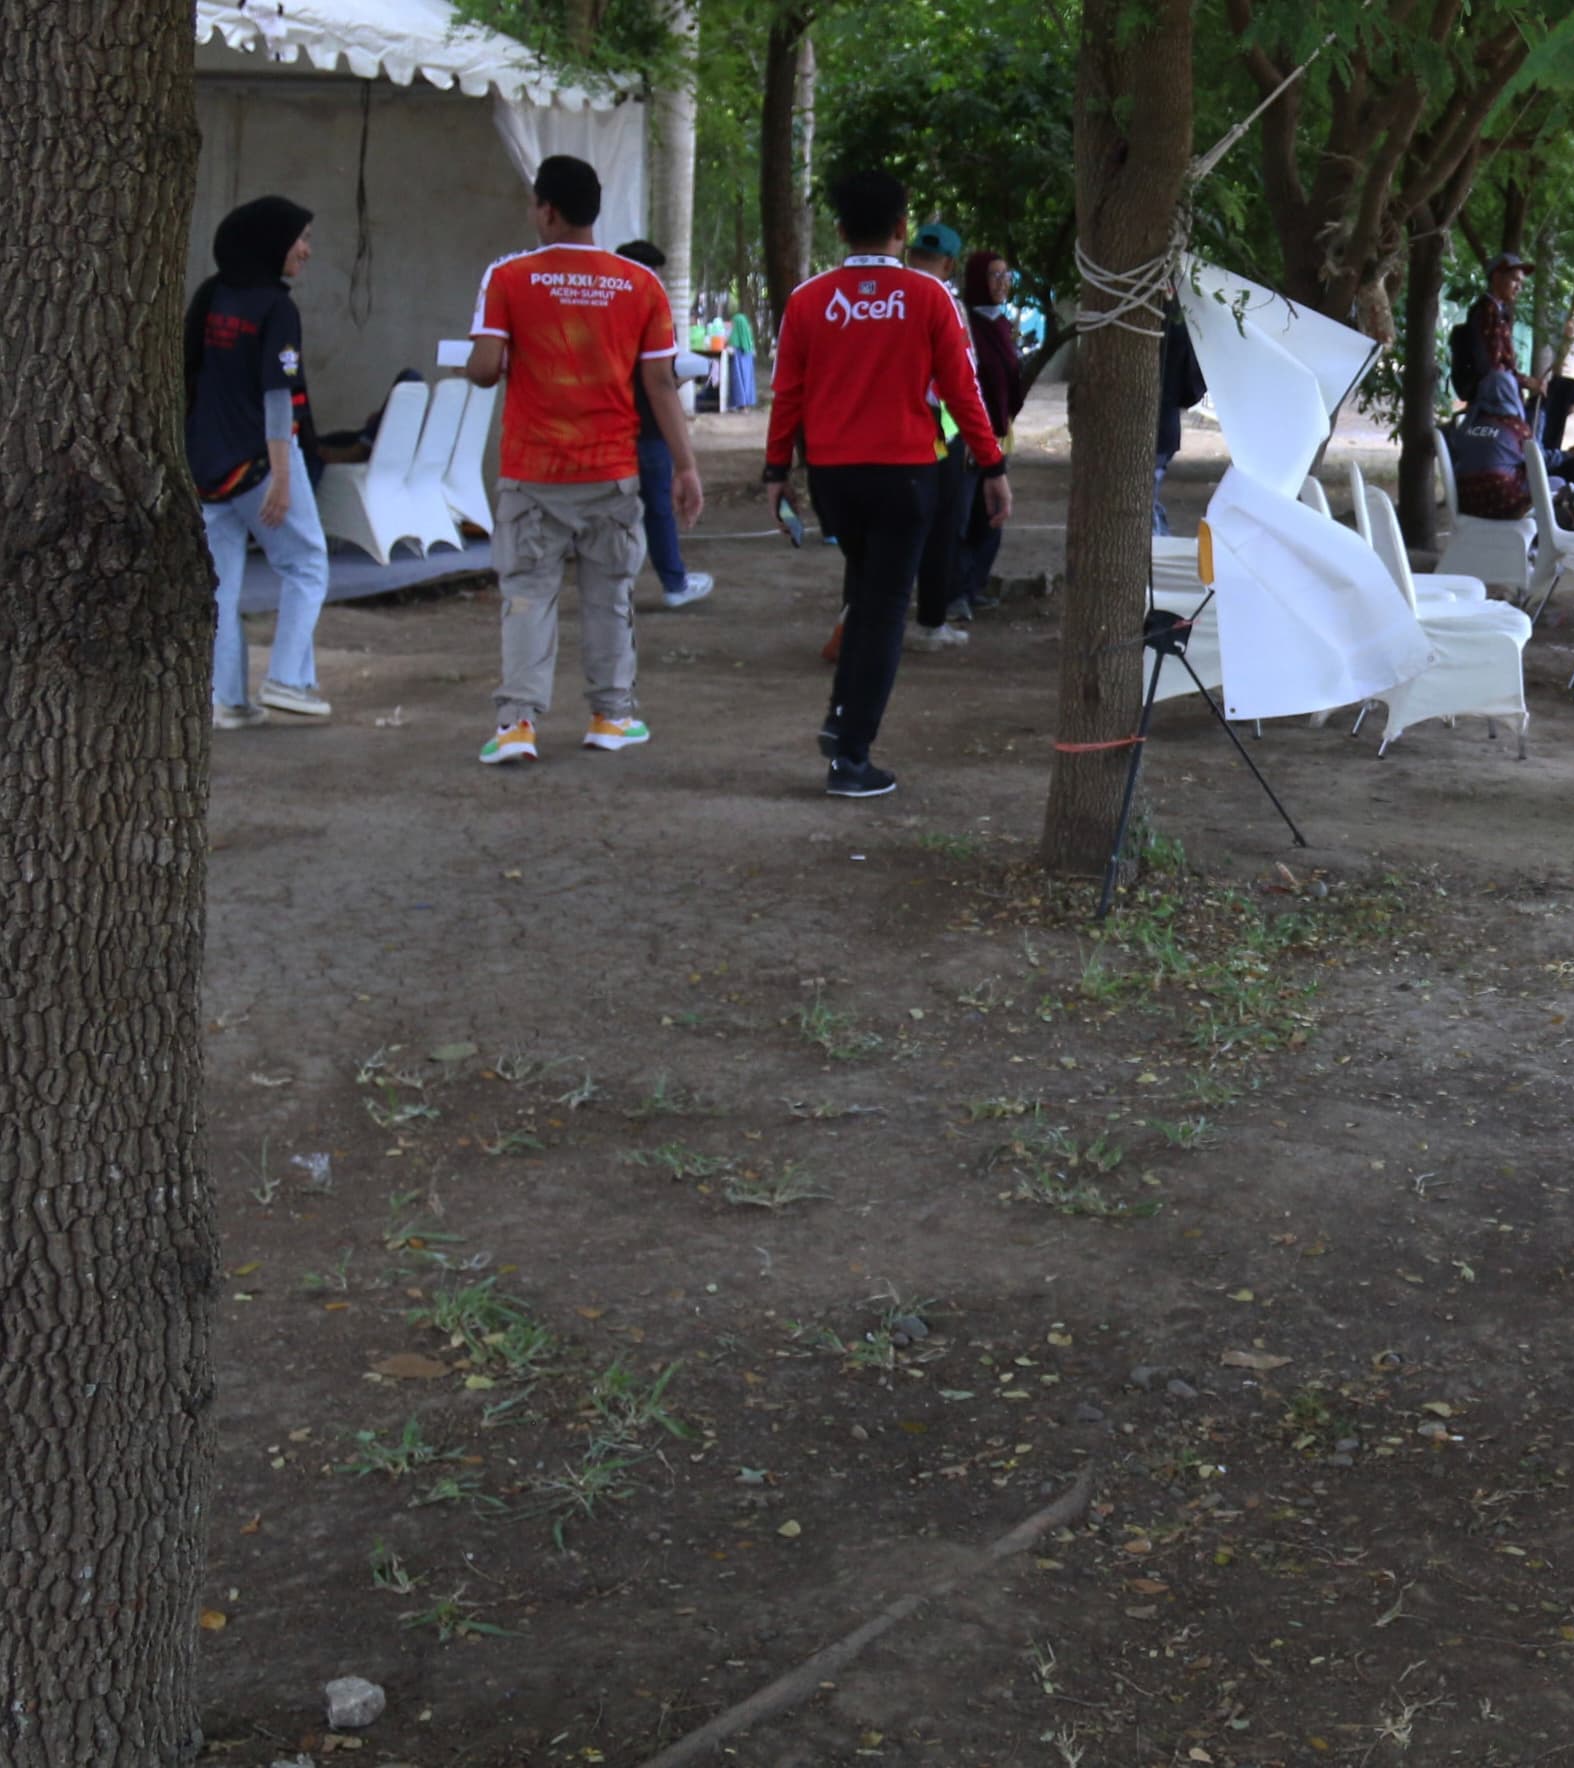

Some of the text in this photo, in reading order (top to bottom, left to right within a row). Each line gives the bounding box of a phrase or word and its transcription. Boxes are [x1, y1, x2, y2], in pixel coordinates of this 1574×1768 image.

[530, 272, 634, 293] PON XXI/2024
[549, 287, 616, 300] ACEH-SUMUT
[825, 287, 905, 329] Aceh
